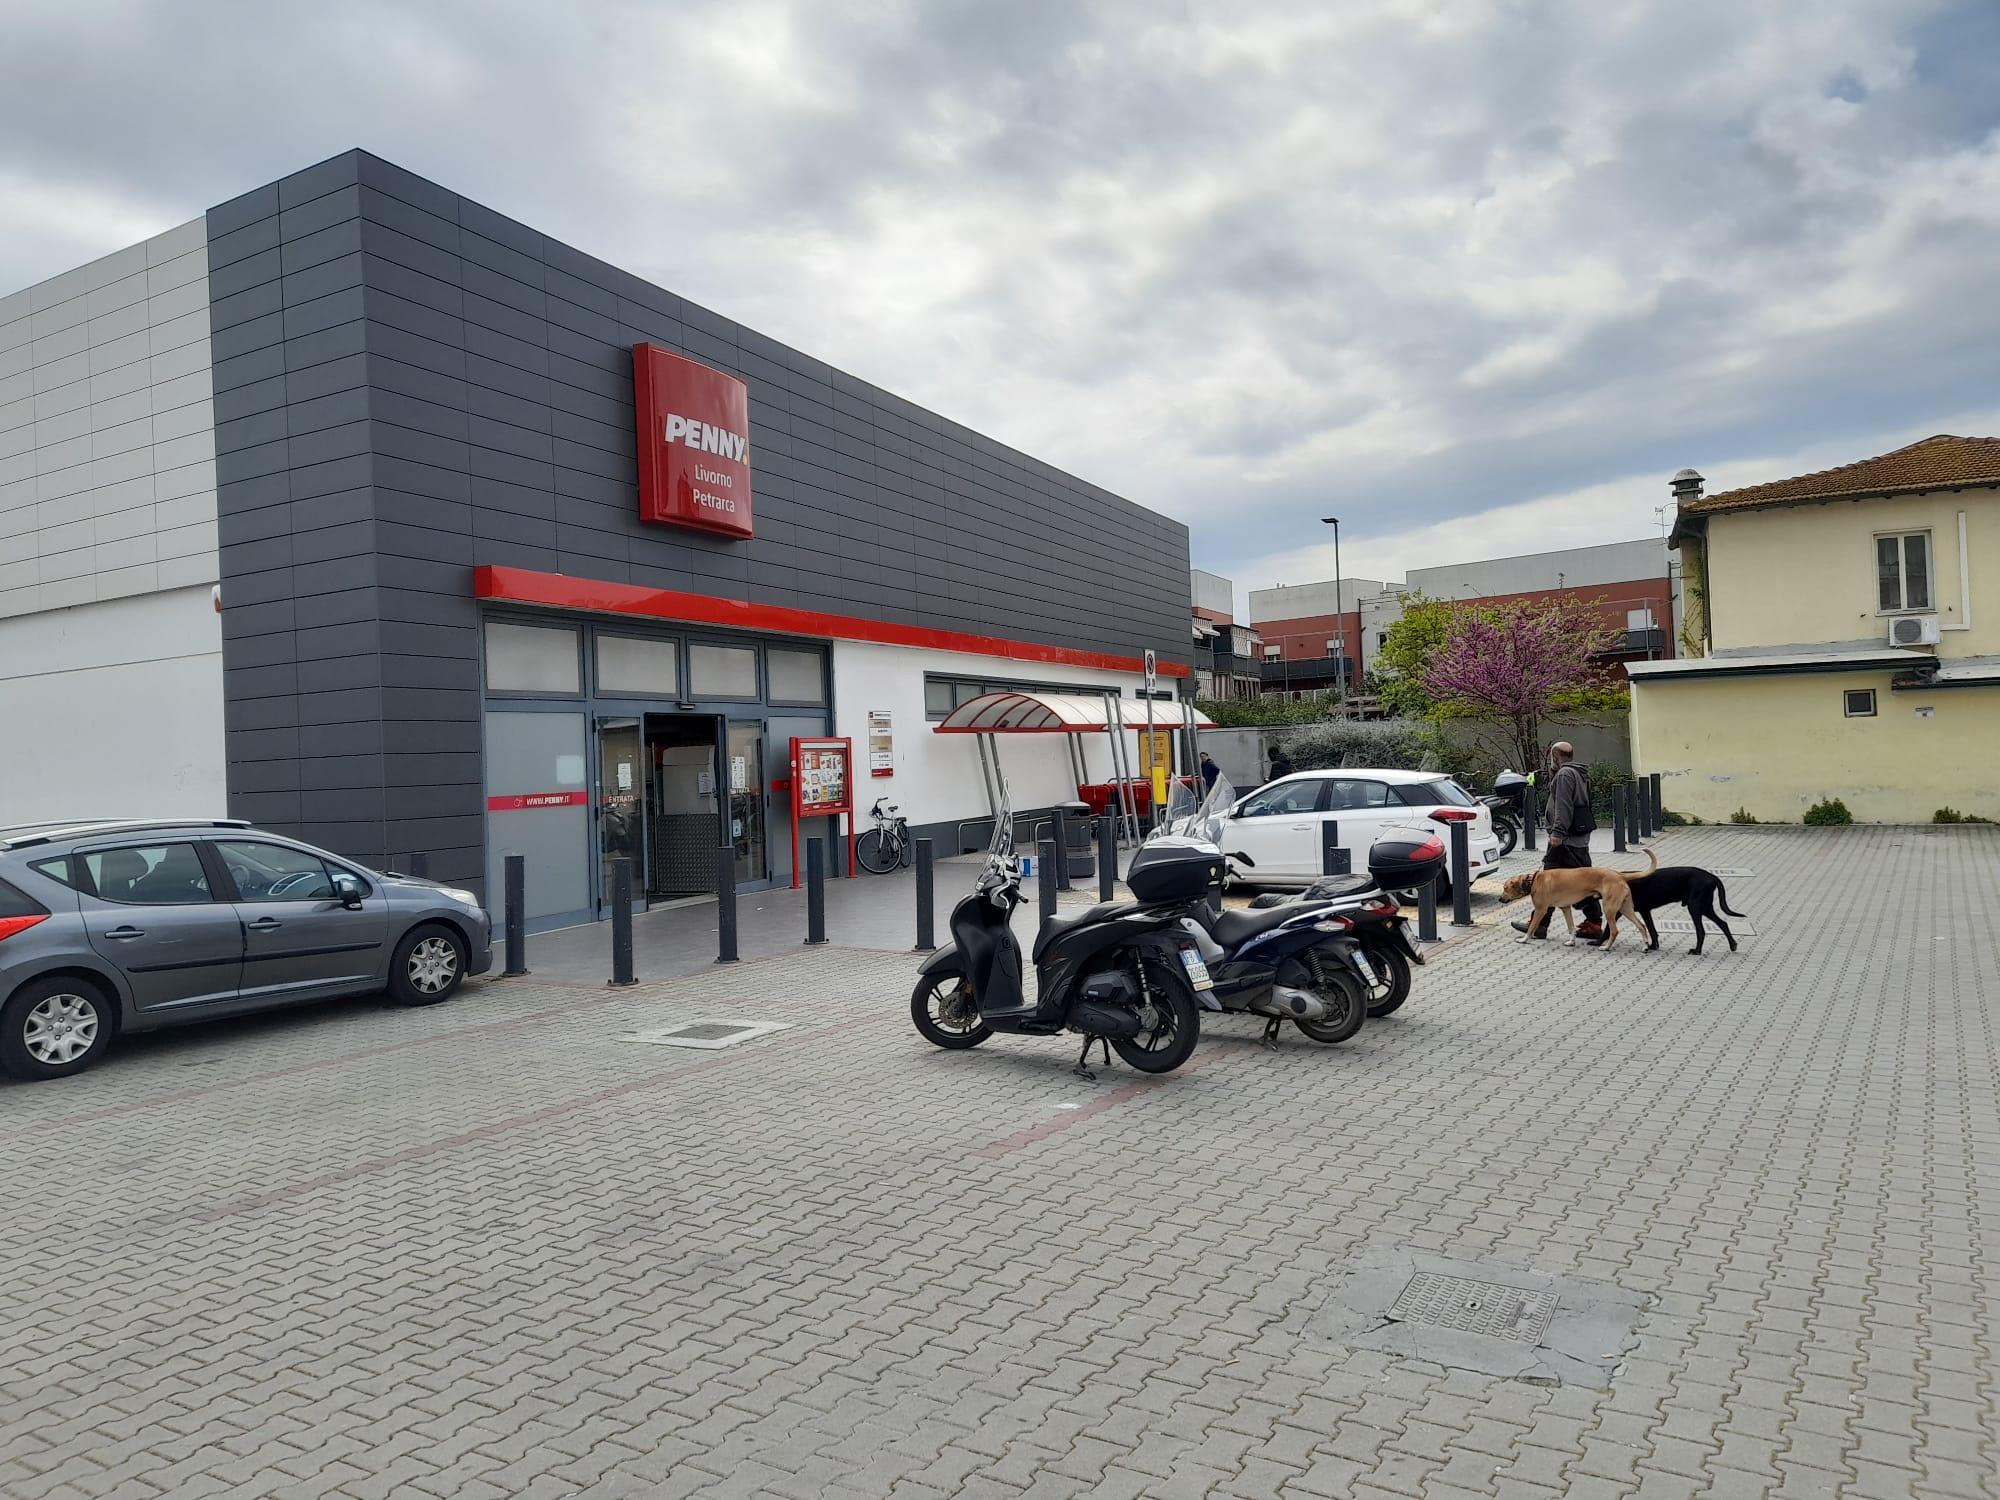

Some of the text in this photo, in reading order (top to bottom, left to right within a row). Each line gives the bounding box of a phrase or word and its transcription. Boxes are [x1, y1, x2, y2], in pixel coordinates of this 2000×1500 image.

[695, 464, 732, 488] Livorno
[693, 488, 735, 513] Petrarca
[608, 795, 634, 803] ENTRATA
